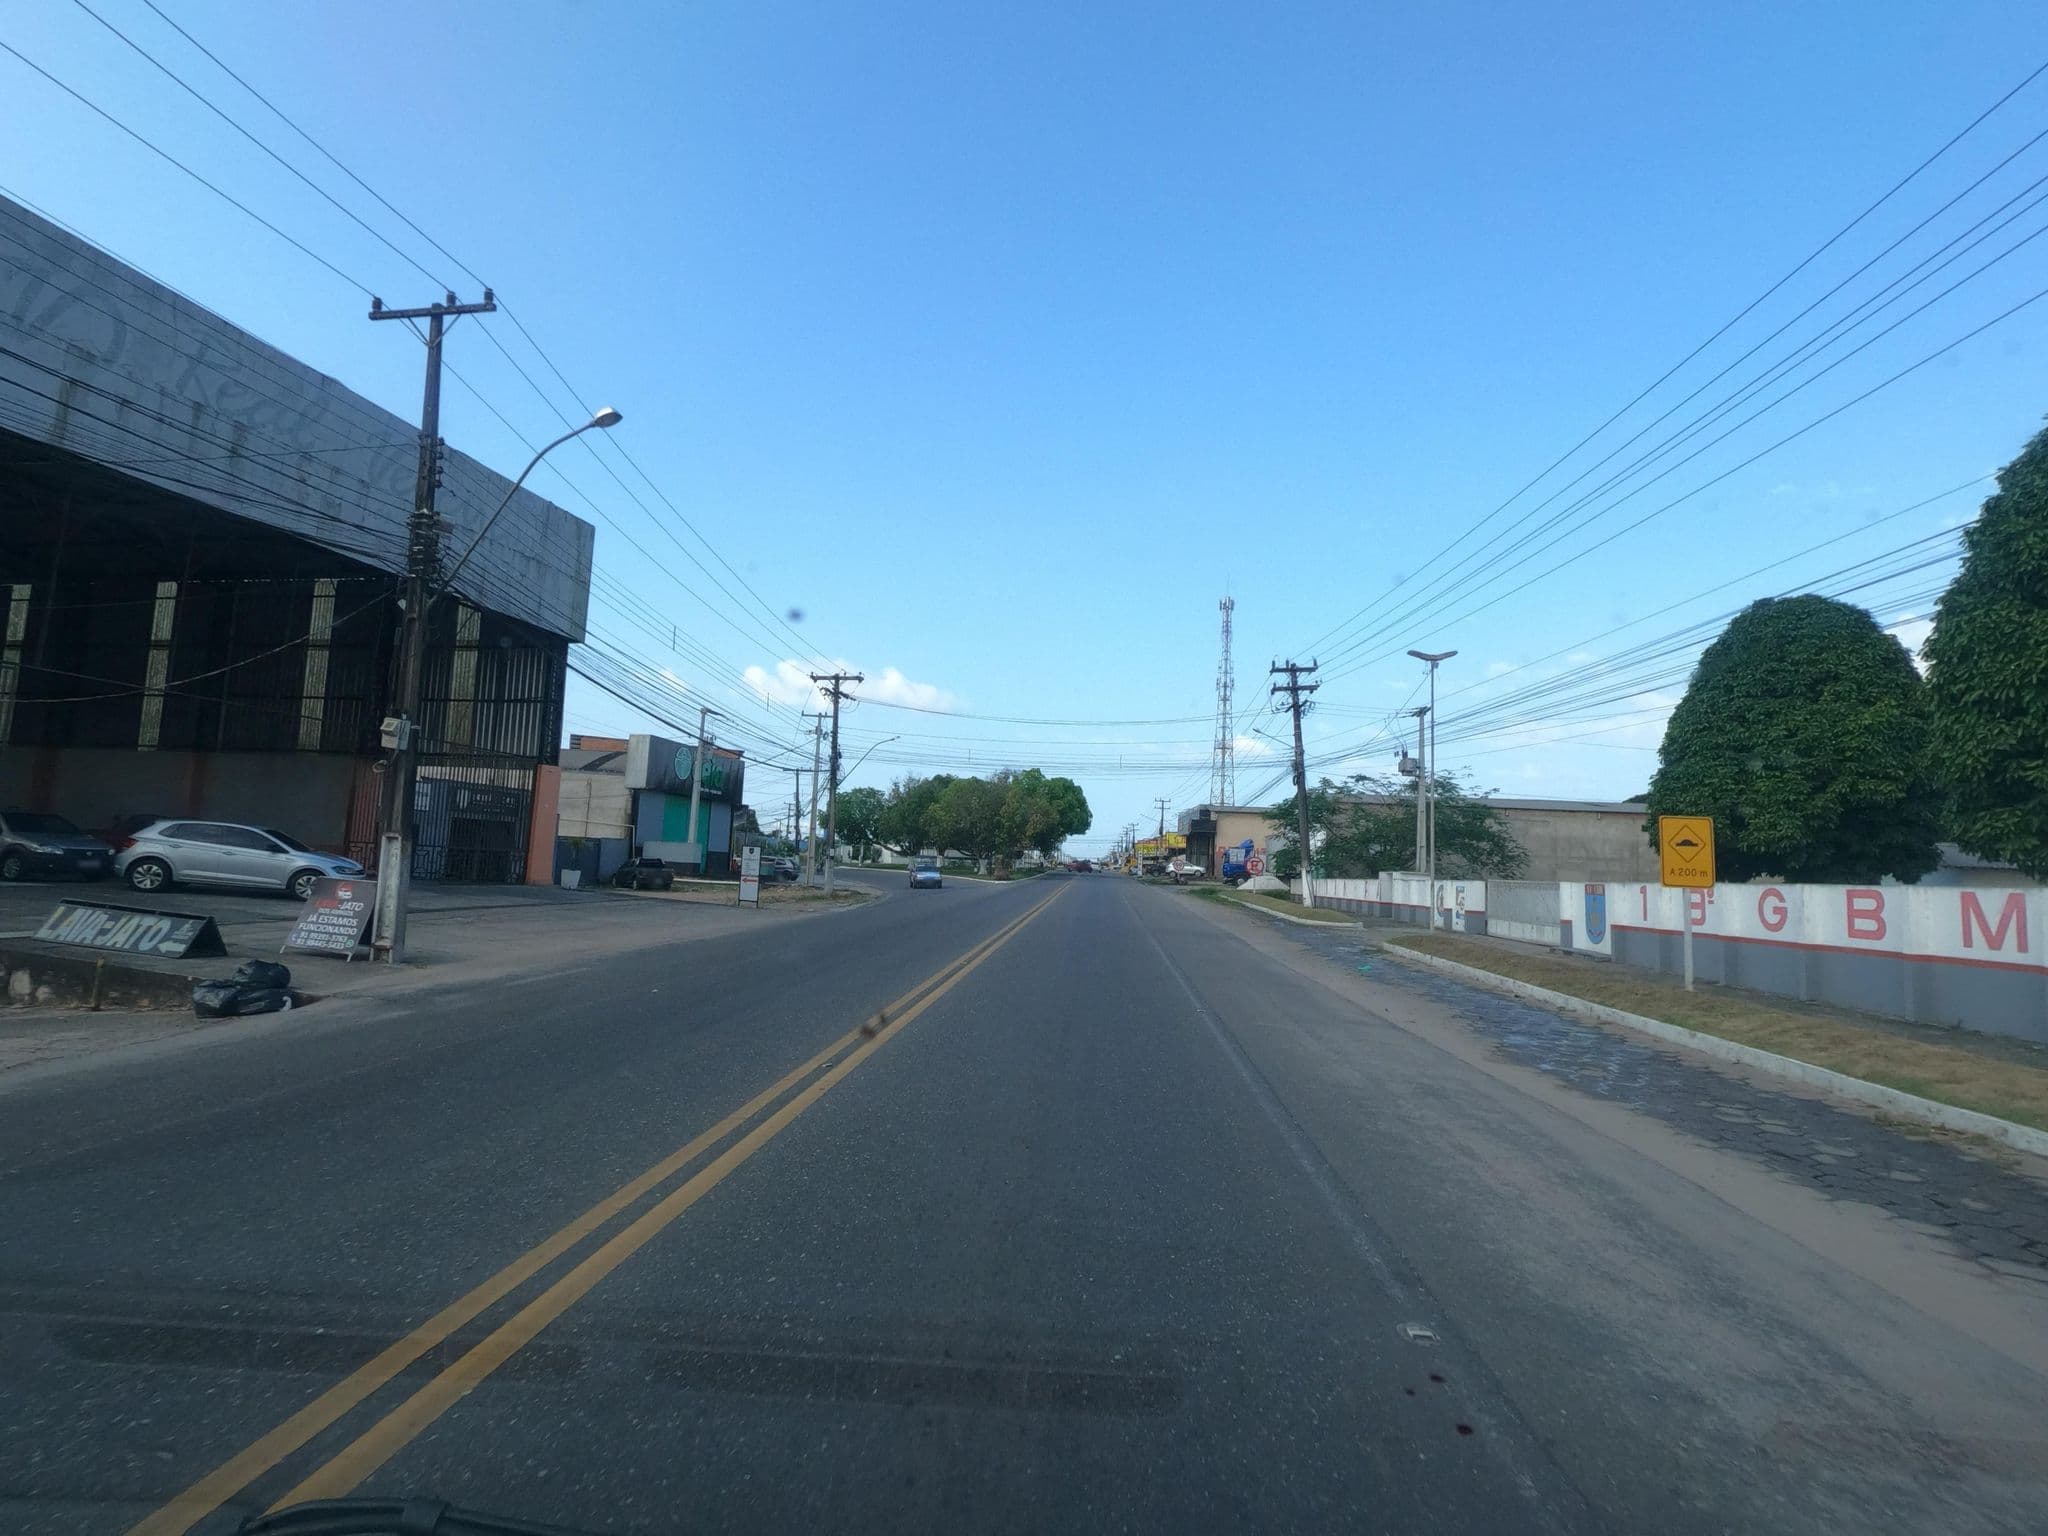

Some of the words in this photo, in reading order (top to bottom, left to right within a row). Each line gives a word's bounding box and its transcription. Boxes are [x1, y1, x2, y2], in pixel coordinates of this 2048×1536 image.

[1669, 868, 1676, 876] A
[1678, 868, 1697, 877] 200
[1700, 870, 1709, 878] m
[318, 915, 359, 927] ESTAMOS
[33, 905, 172, 951] LAVA-JATO
[298, 922, 358, 935] FUNCIONANDO
